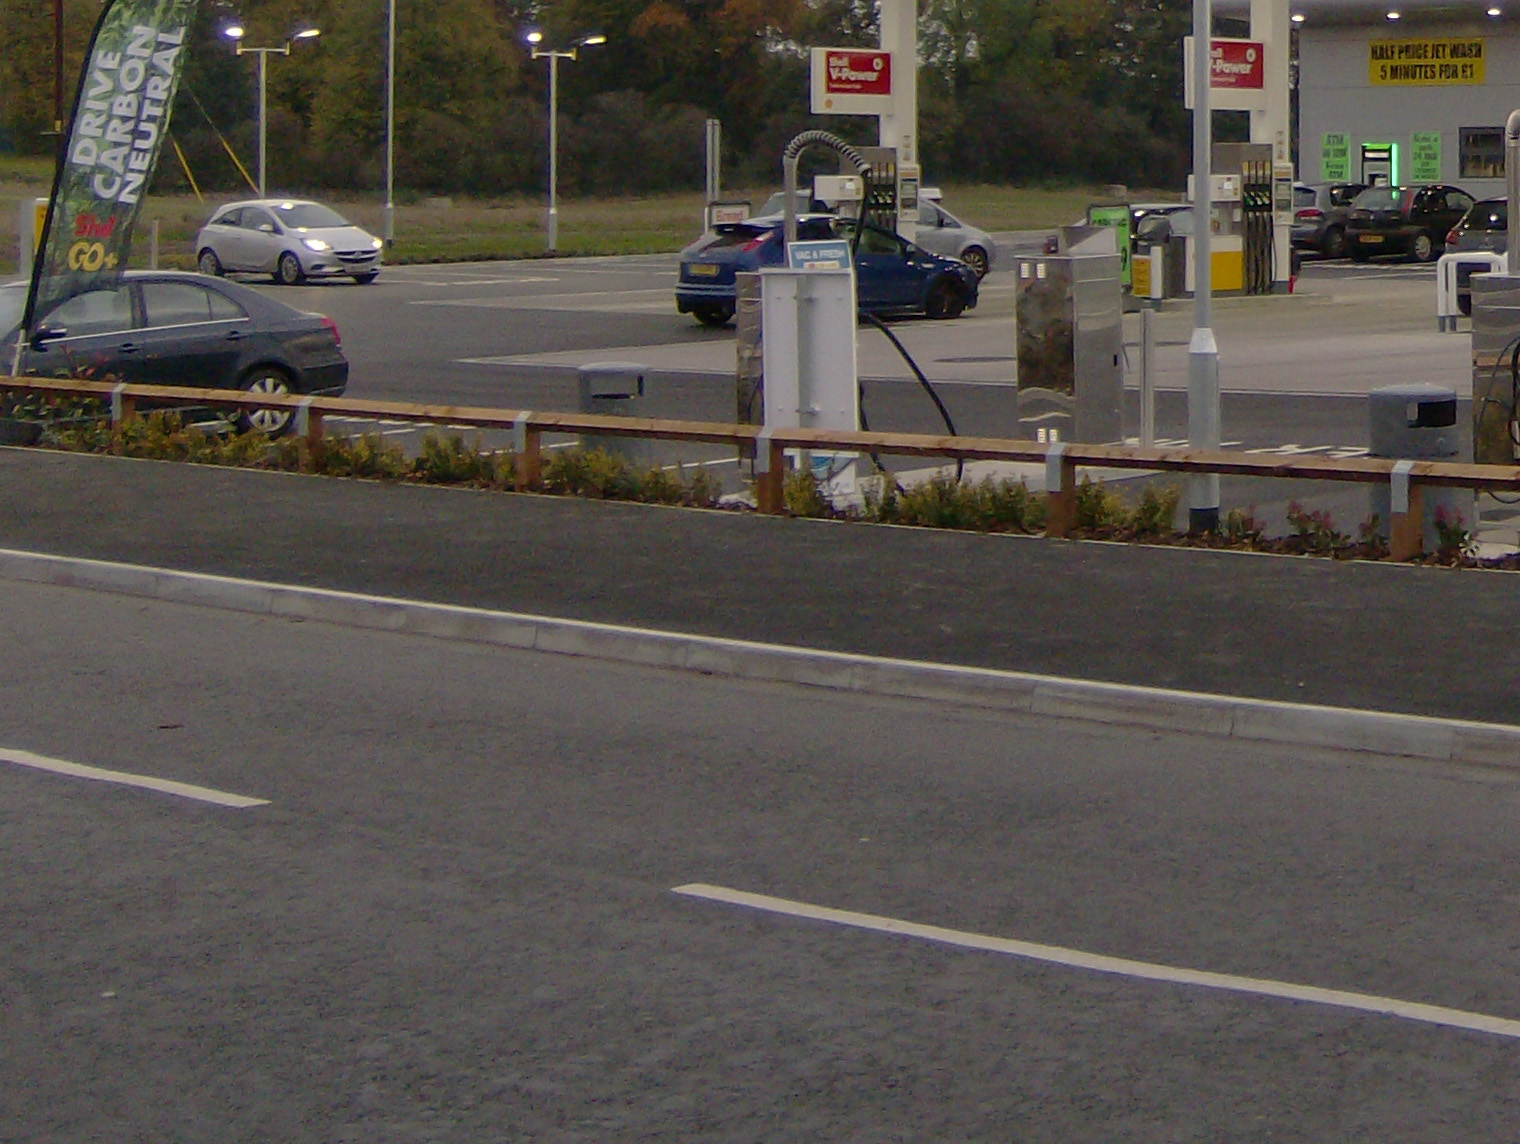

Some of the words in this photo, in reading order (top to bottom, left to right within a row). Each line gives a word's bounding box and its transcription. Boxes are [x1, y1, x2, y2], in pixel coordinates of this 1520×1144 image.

[1371, 44, 1394, 60] HALF
[1431, 43, 1448, 59] JET
[1449, 42, 1482, 58] WASH
[829, 66, 879, 82] V-Power
[1211, 58, 1252, 74] -Power
[1380, 64, 1387, 80] 5
[1390, 64, 1436, 80] MINUTES
[1438, 64, 1458, 79] FOR
[1461, 63, 1474, 79] £1
[72, 50, 122, 166] DRIVE
[94, 25, 156, 199] CARBON
[117, 25, 187, 205] NEUTRAL
[794, 250, 811, 260] VAC
[819, 248, 845, 258] FRESH
